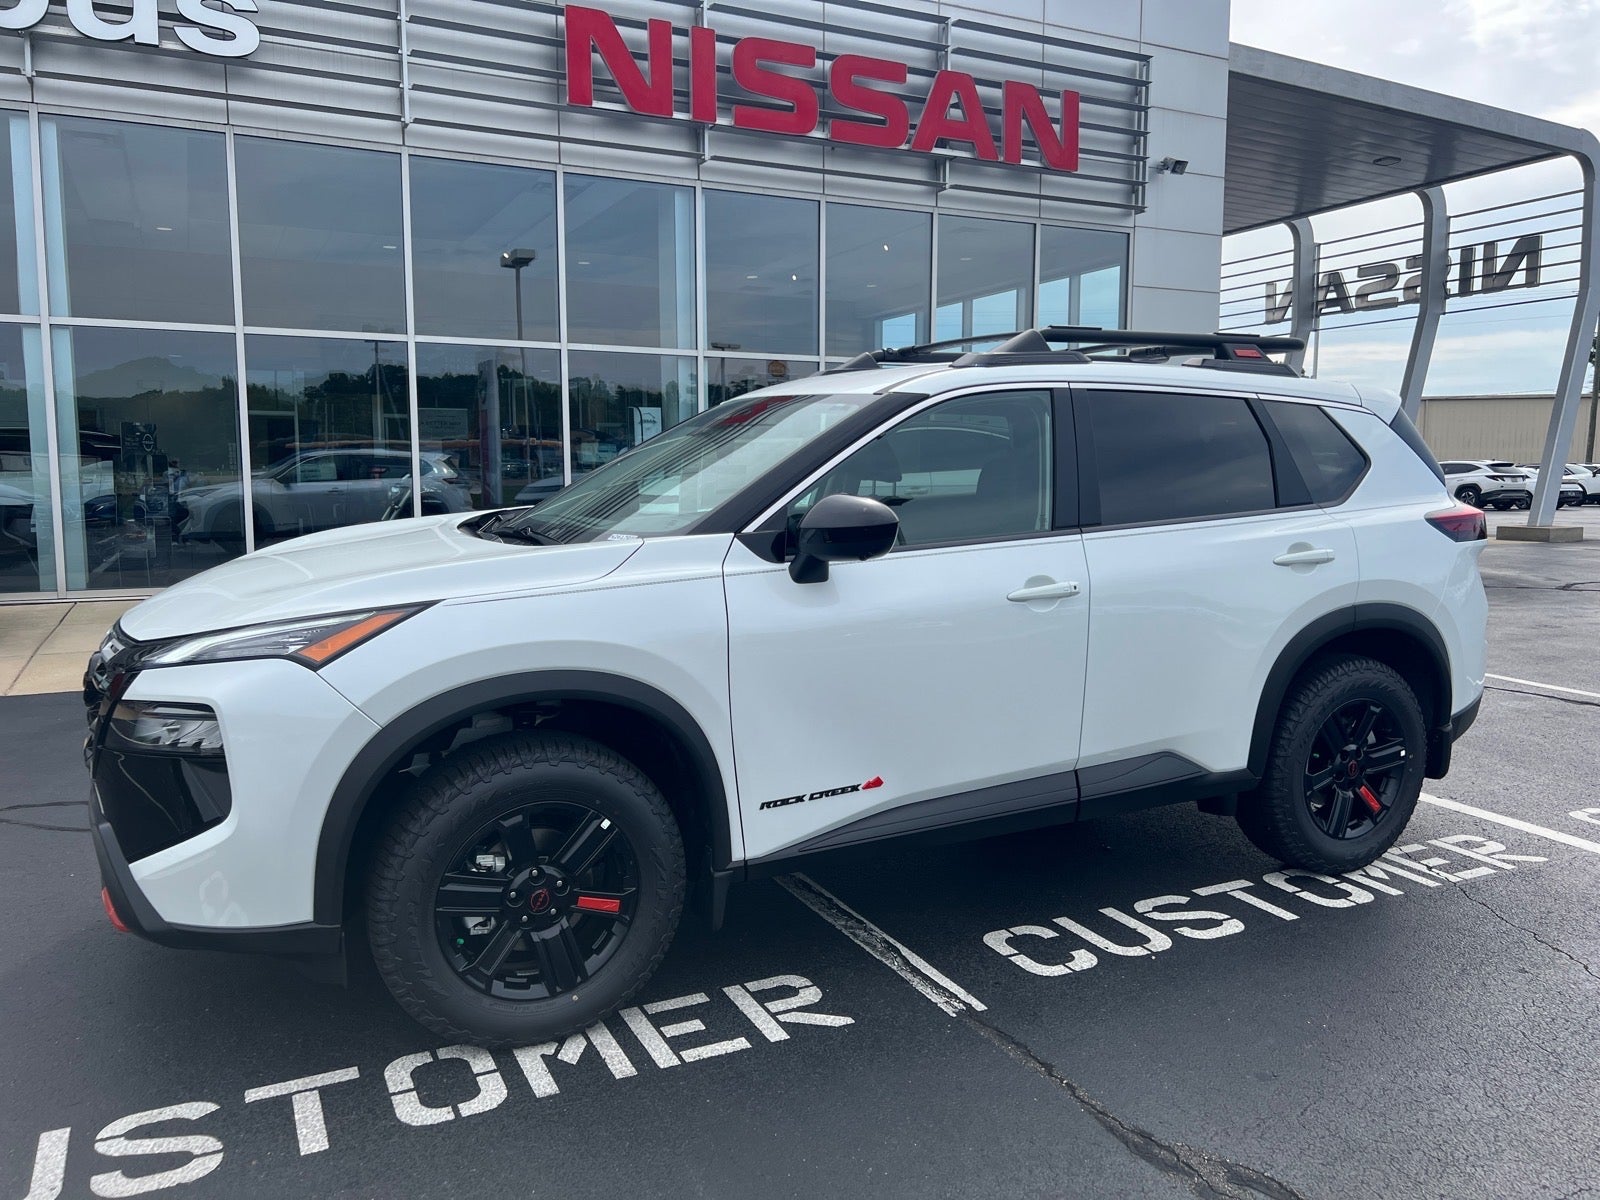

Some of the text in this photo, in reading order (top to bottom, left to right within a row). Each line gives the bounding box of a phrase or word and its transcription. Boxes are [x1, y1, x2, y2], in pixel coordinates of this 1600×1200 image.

[565, 4, 1080, 172] NISSAN
[759, 783, 862, 811] ROCK CREEK
[983, 834, 1549, 977] CUSTOMER
